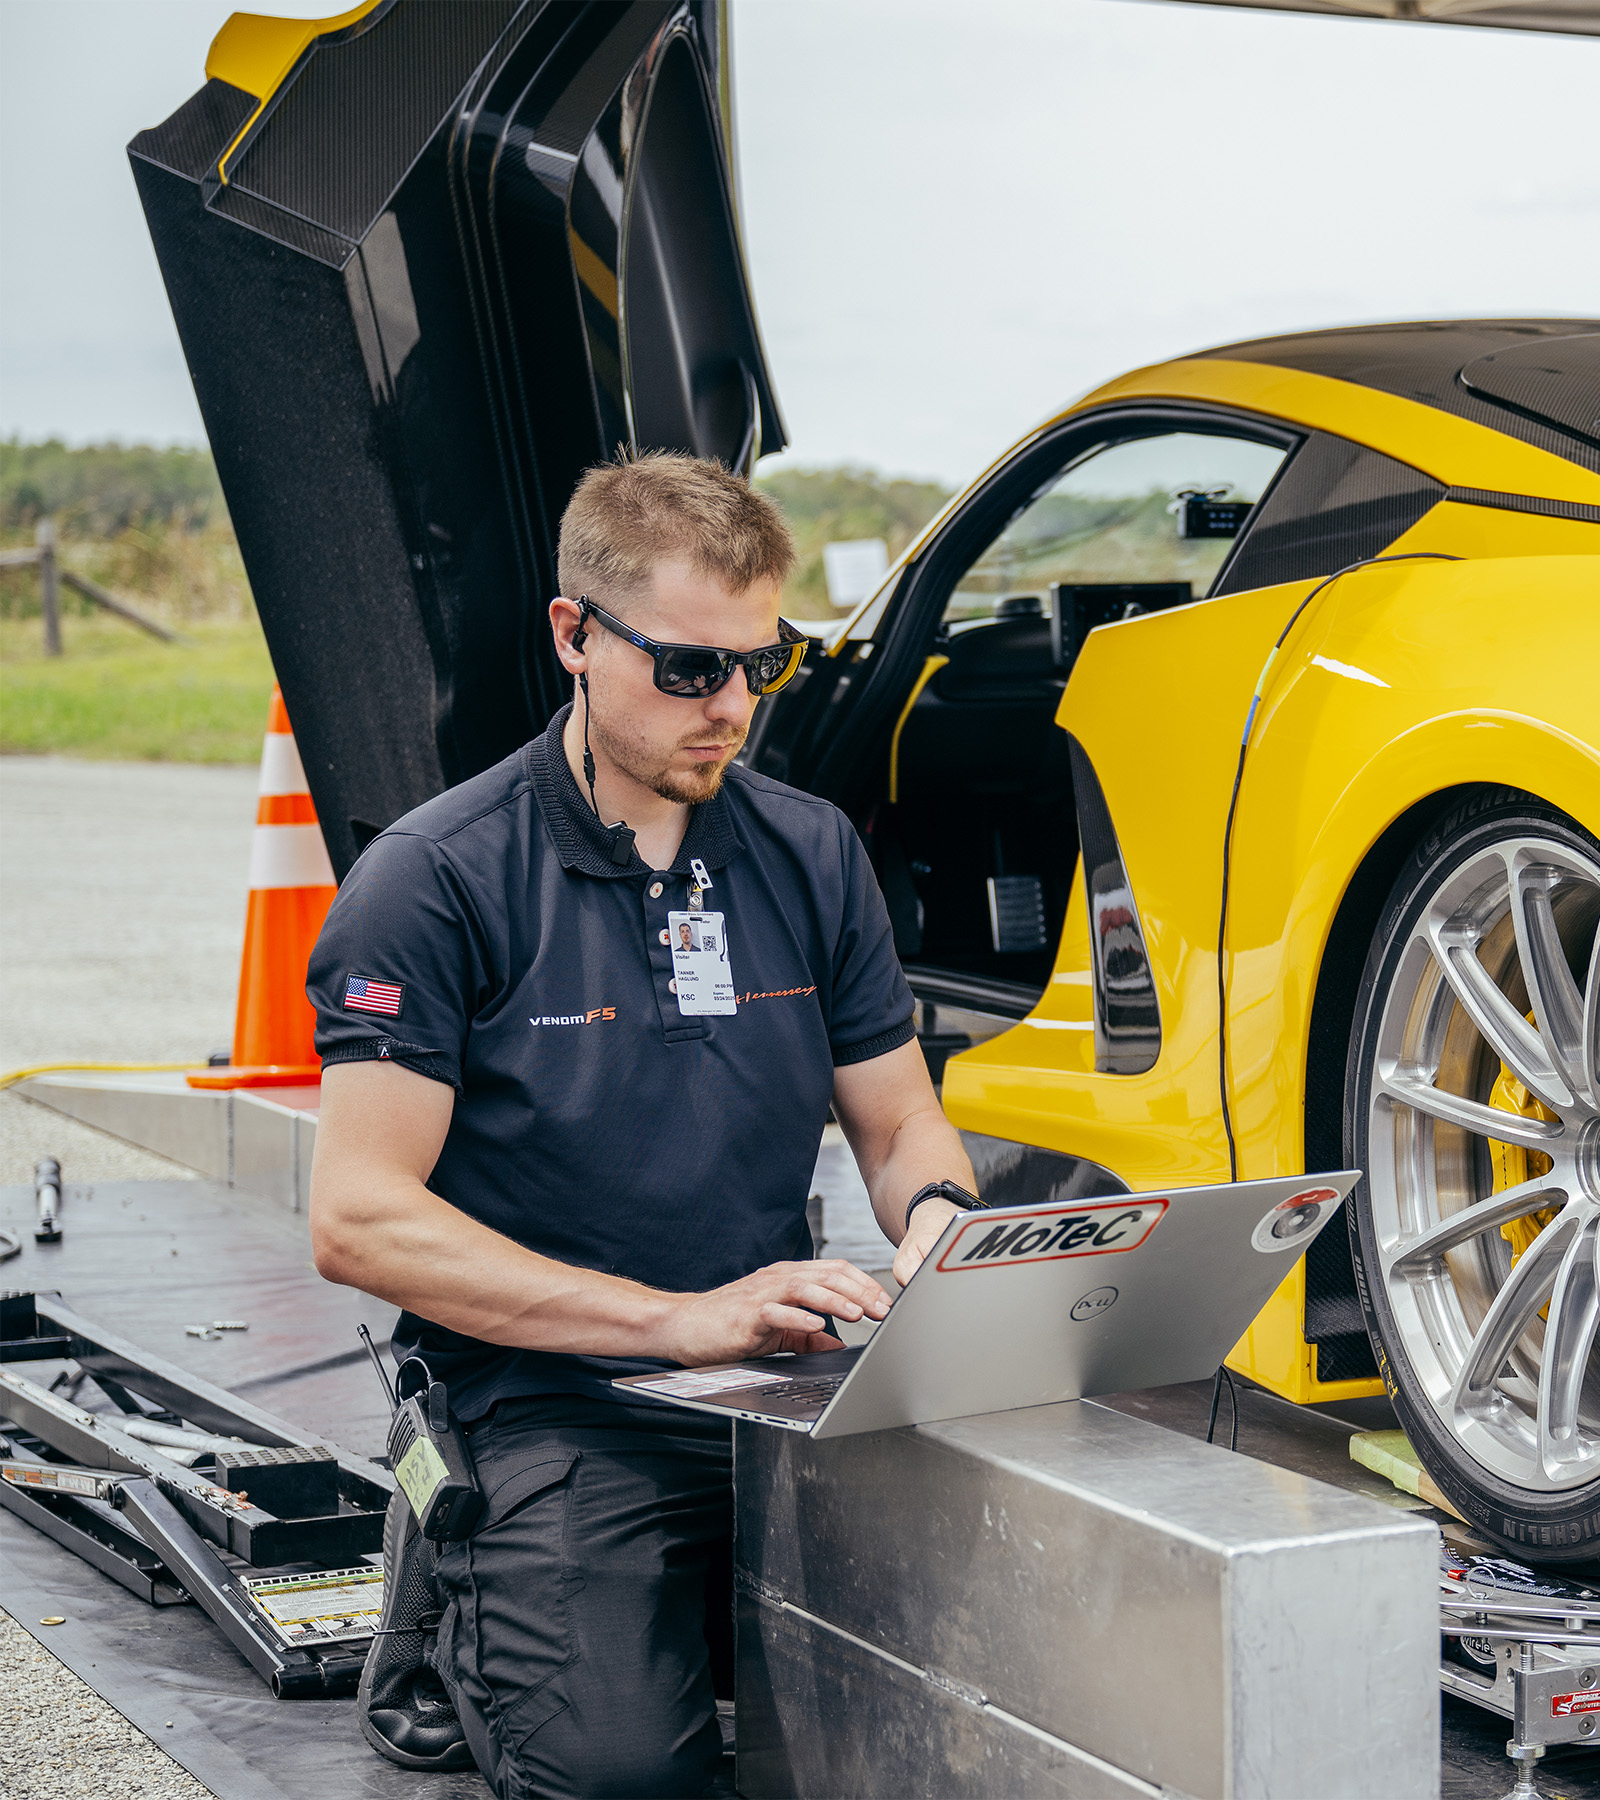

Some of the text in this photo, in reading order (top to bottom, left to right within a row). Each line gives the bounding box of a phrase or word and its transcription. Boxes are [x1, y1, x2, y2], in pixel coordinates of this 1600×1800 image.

[680, 993, 696, 1001] KSC
[735, 984, 818, 1005] Hennessey
[529, 1006, 617, 1027] VENOM F5
[961, 1210, 1143, 1263] MoTeC
[1442, 1476, 1468, 1506] CUP
[1468, 1498, 1491, 1517] SPORT
[1468, 1506, 1490, 1525] PILOT
[248, 1566, 384, 1588] QUICKJAC
